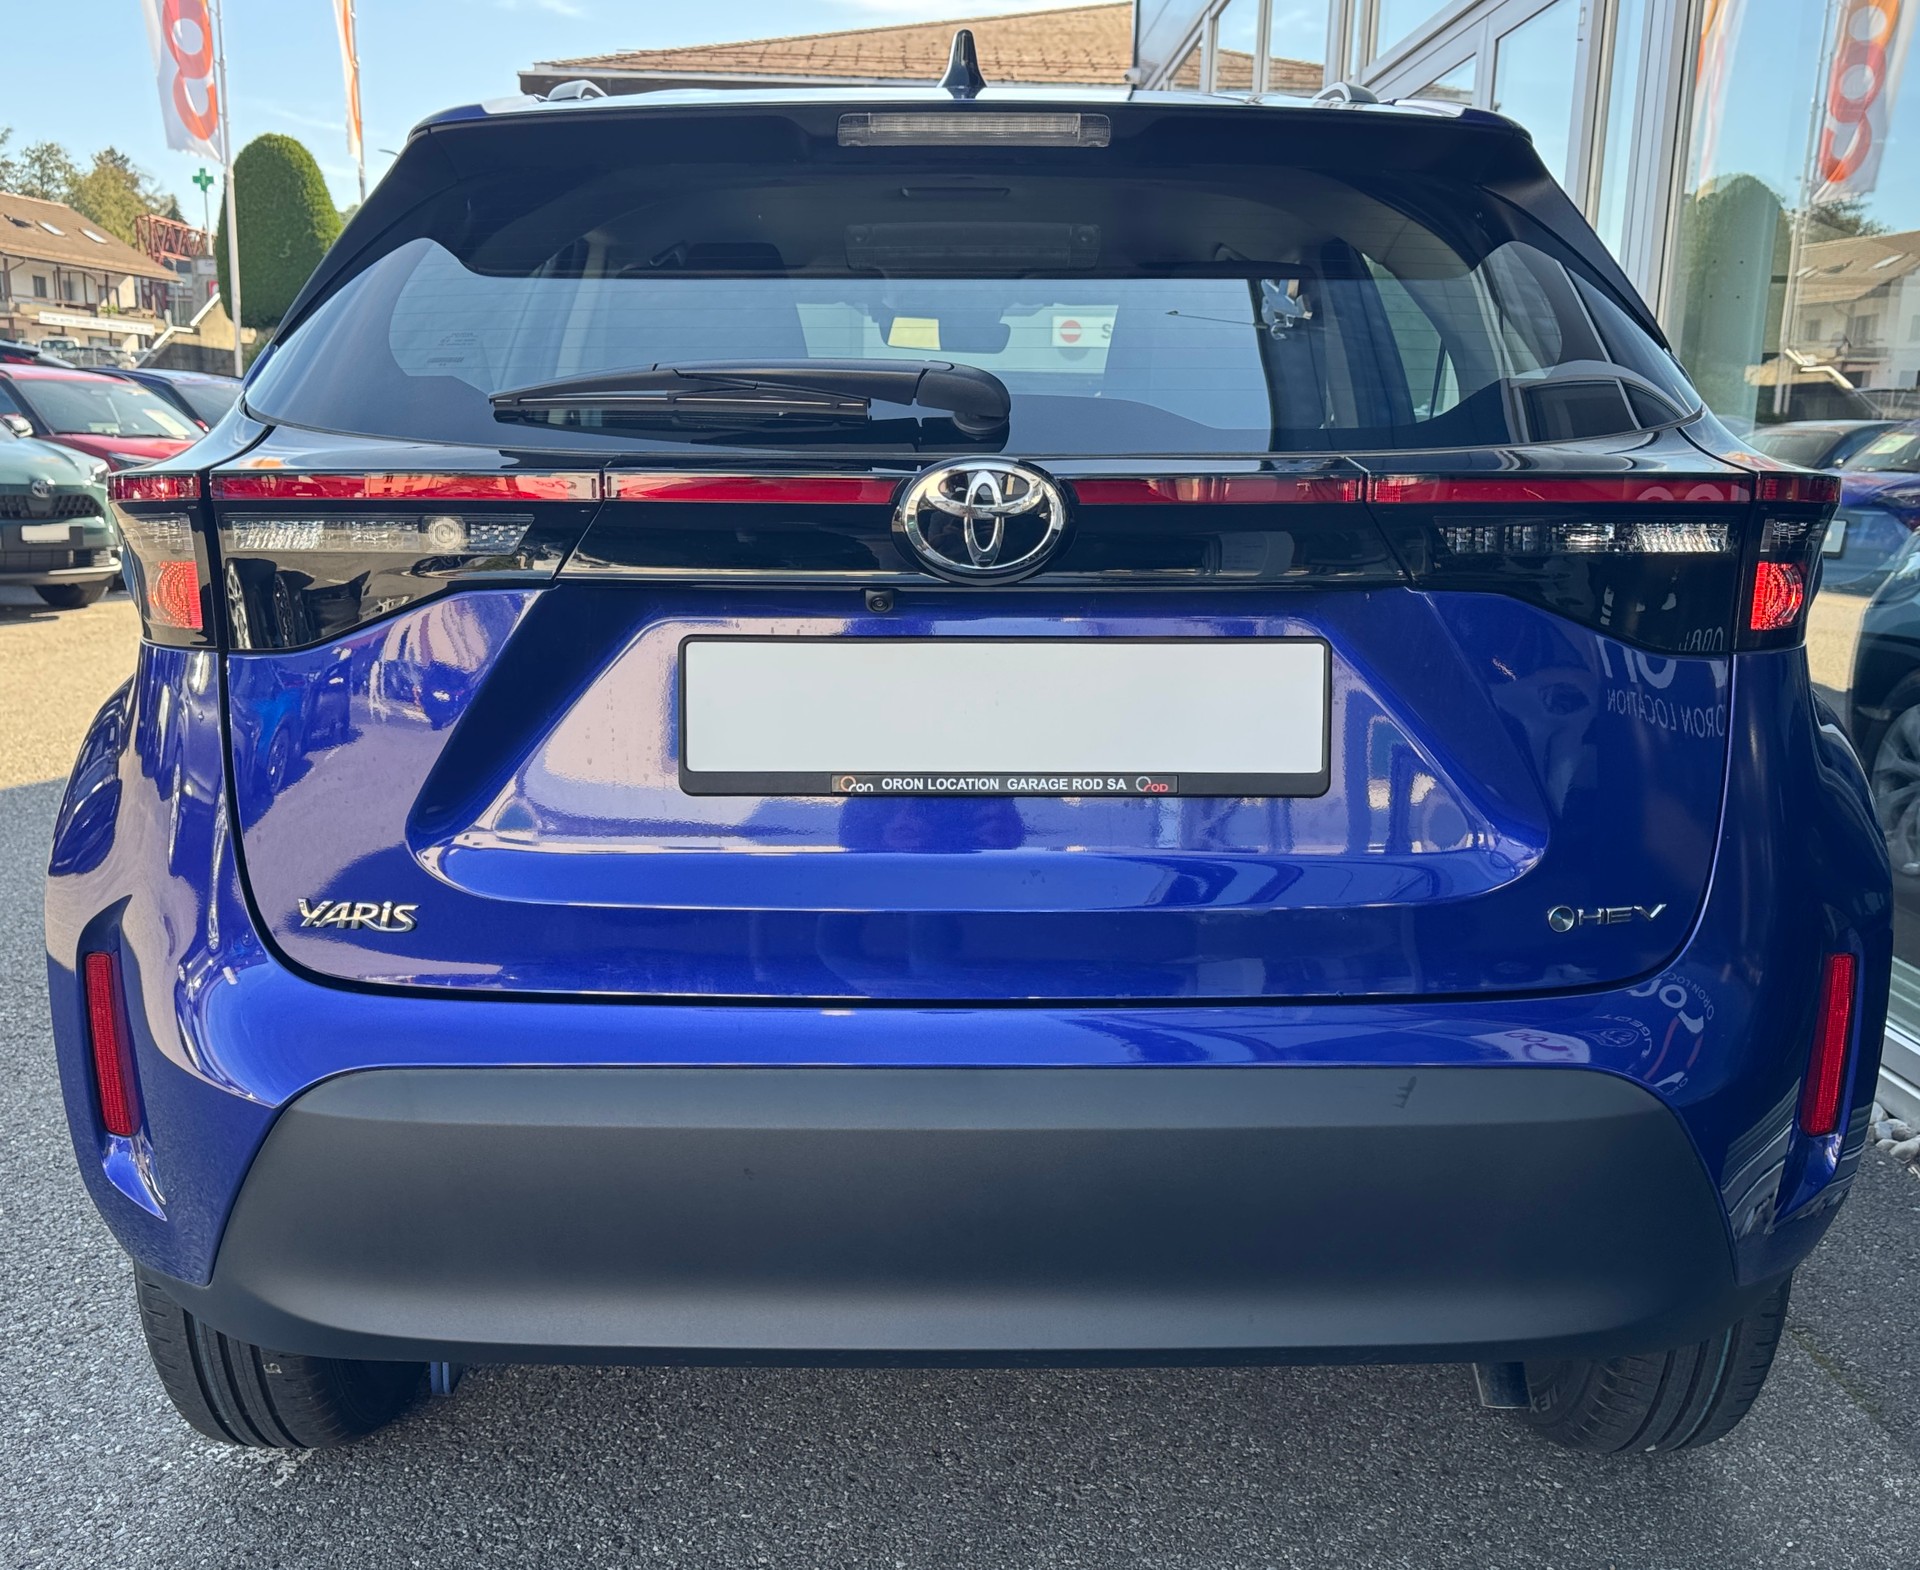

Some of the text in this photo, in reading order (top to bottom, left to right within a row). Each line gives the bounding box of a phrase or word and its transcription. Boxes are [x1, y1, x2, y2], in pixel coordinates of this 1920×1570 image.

[881, 778, 924, 790] ORON
[927, 778, 999, 790] LOCATION
[1007, 778, 1069, 790] GARAGE
[1072, 778, 1104, 790] ROD
[1106, 778, 1127, 790] SA
[1577, 903, 1667, 926] HEV
